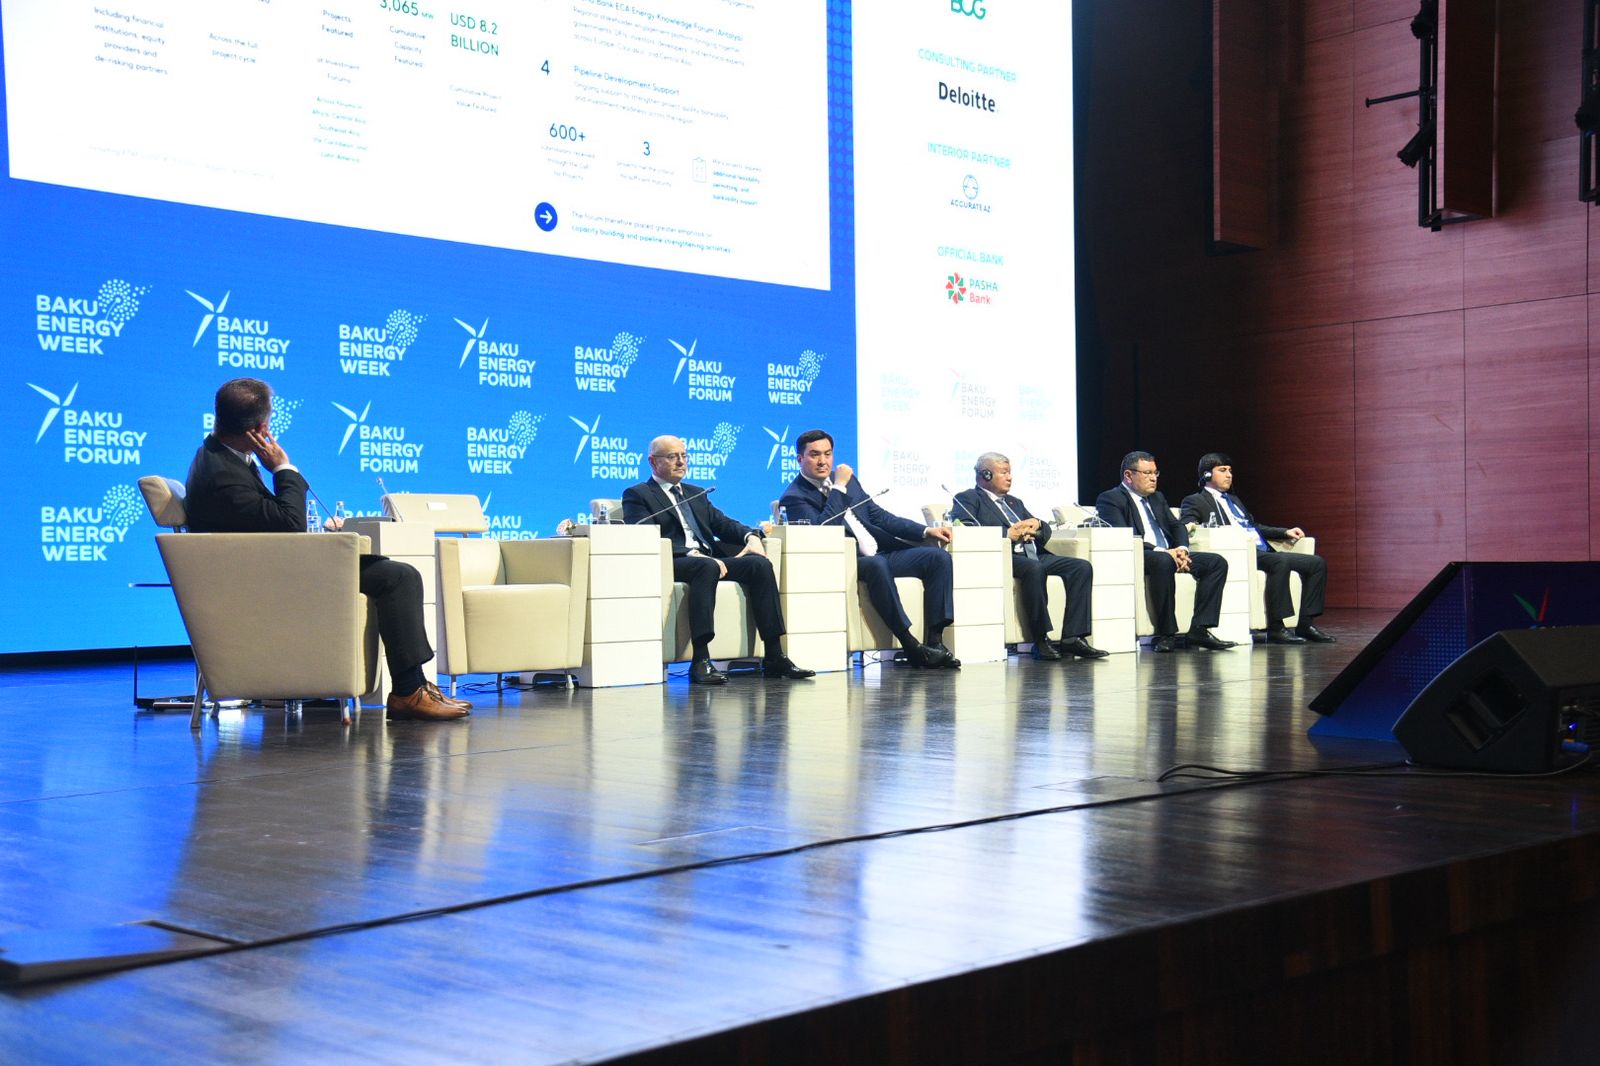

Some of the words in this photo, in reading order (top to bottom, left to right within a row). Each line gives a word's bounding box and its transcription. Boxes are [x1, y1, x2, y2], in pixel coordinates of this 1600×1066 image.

[615, 2, 630, 12] ECA
[631, 6, 655, 21] Energy
[950, 0, 988, 20] BCG
[450, 12, 476, 31] USD
[479, 19, 498, 36] 8.2
[450, 34, 500, 57] BILLION
[540, 59, 550, 76] 4
[917, 48, 977, 73] CONSULTING
[977, 62, 1018, 82] PARTNER
[573, 64, 603, 80] Pipeline
[603, 72, 651, 90] Development
[652, 82, 680, 96] Support
[938, 81, 996, 113] Deloitte
[549, 122, 587, 142] 600+
[642, 140, 651, 157] 3
[927, 141, 969, 160] INTERIOR
[970, 150, 1012, 169] PARTNER
[936, 245, 977, 263] OFFICIAL
[979, 251, 1005, 266] BANK
[969, 277, 999, 292] PASHA
[36, 294, 98, 317] BAKU
[969, 292, 992, 305] Bank
[36, 314, 125, 337] ENERGY
[217, 316, 269, 336] BAKU
[339, 324, 387, 343] BAKU
[37, 333, 104, 356] WEEK
[217, 334, 291, 354] ENERGY
[339, 342, 407, 361] ENERGY
[478, 340, 519, 357] BAKU
[218, 351, 285, 371] FORUM
[574, 345, 613, 362] BAKU
[340, 358, 391, 377] WEEK
[478, 356, 536, 374] ENERGY
[575, 362, 629, 379] ENERGY
[688, 359, 723, 375] BAKU
[767, 363, 800, 378] BAKU
[479, 372, 532, 389] FORUM
[575, 377, 616, 393] WEEK
[688, 373, 736, 390] ENERGY
[767, 377, 813, 392] ENERGY
[961, 383, 987, 394] BAKU
[689, 388, 733, 402] FORUM
[768, 391, 802, 406] WEEK
[961, 395, 997, 408] ENERGY
[64, 409, 123, 429] BAKU
[961, 408, 995, 418] FORUM
[64, 428, 148, 448] ENERGY
[359, 425, 405, 442] BAKU
[467, 427, 509, 443] BAKU
[360, 441, 424, 458] ENERGY
[467, 443, 527, 460] ENERGY
[591, 435, 628, 451] BAKU
[781, 445, 797, 458] BA
[64, 447, 141, 465] FORUM
[591, 450, 644, 466] ENERGY
[687, 452, 729, 467] NERGY
[892, 450, 920, 462] BAKU
[360, 457, 419, 474] FORUM
[468, 459, 513, 475] WEEK
[592, 465, 639, 480] FORUM
[893, 462, 931, 474] ENERGY
[893, 476, 928, 487] FORUM
[41, 506, 103, 524] BAKU
[41, 525, 129, 543] ENERGY
[42, 544, 108, 562] WEEK
